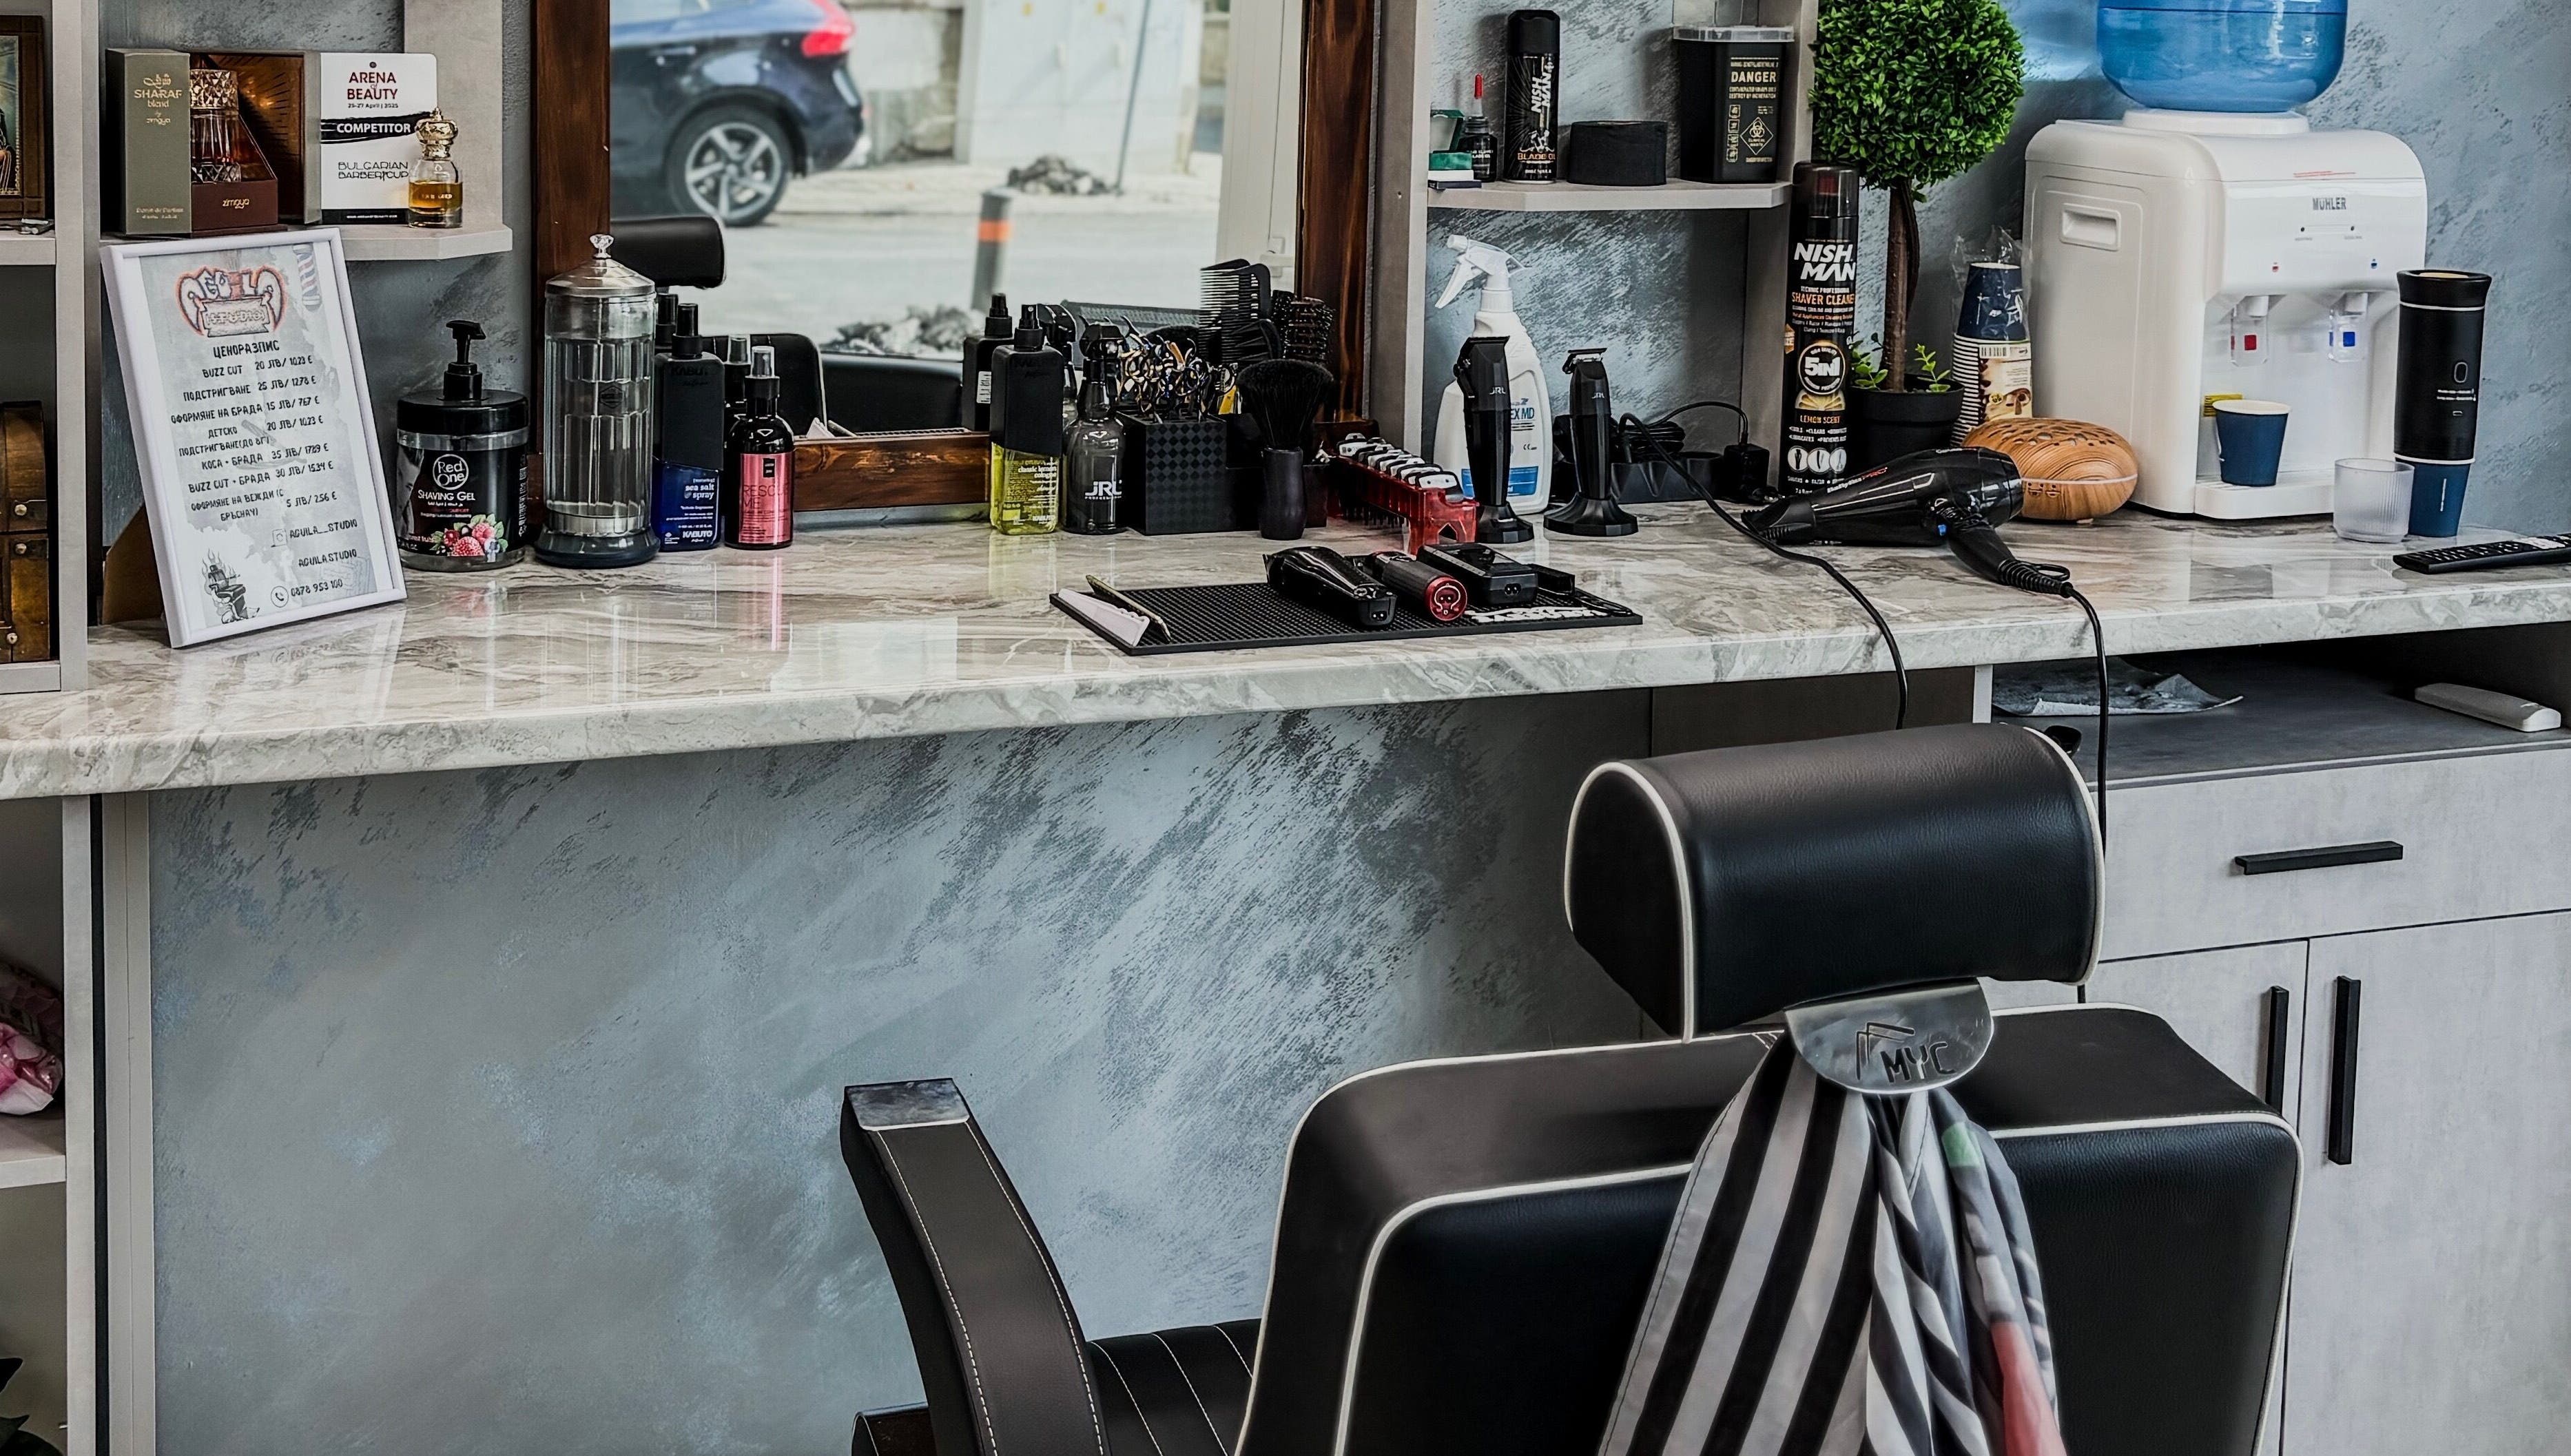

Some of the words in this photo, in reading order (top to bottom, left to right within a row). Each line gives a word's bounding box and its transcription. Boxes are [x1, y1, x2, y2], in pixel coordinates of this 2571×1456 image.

[349, 72, 396, 83] ARENA
[1731, 71, 1776, 83] DANGER
[134, 89, 182, 98] SHARAF
[347, 89, 398, 100] BEAUTY
[336, 123, 411, 133] COMPETITOR
[338, 162, 408, 170] BULGARIAN
[1793, 242, 1853, 262] NISH
[1800, 262, 1856, 281] MAN
[1792, 292, 1824, 304] SHAVER
[1826, 293, 1855, 305] CLEANE
[213, 340, 280, 359] ЦЕНОРАЗПИС
[202, 366, 225, 378] BUZZ
[227, 365, 242, 375] CUT
[255, 361, 265, 370] 20
[183, 384, 251, 402] ПОДСТРИГВАНЕ
[258, 382, 267, 391] 25
[171, 409, 216, 424] ОФОРМЯНЕ
[218, 408, 229, 417] НА
[231, 404, 262, 417] БРАДА
[267, 402, 276, 410] 15
[1521, 407, 1535, 419] MD
[208, 426, 238, 439] ДЕТСКО
[267, 422, 276, 431] 20
[202, 459, 223, 470] КОСА
[231, 453, 263, 466] БРАДА
[271, 450, 282, 459] 35
[437, 460, 463, 473] Red
[188, 481, 211, 493] BUZZ
[214, 479, 229, 489] CUT
[238, 472, 271, 486] БРАДА
[276, 468, 285, 478] 30
[437, 473, 465, 486] One
[700, 483, 714, 491] salt
[743, 485, 789, 497] RESC
[1085, 481, 1122, 496] JRL
[191, 497, 229, 512] ОФОРМЯНЕ
[231, 495, 242, 504] НА
[245, 490, 274, 503] ВЕЖДИ
[417, 489, 454, 501] SHAVING
[457, 492, 475, 501] GEL
[692, 492, 714, 501] spray
[287, 499, 291, 508] 5
[744, 497, 761, 509] ME
[291, 585, 311, 596] 0878
[313, 581, 329, 592] 953
[331, 579, 343, 589] 100
[1881, 1041, 1956, 1083] MYC
